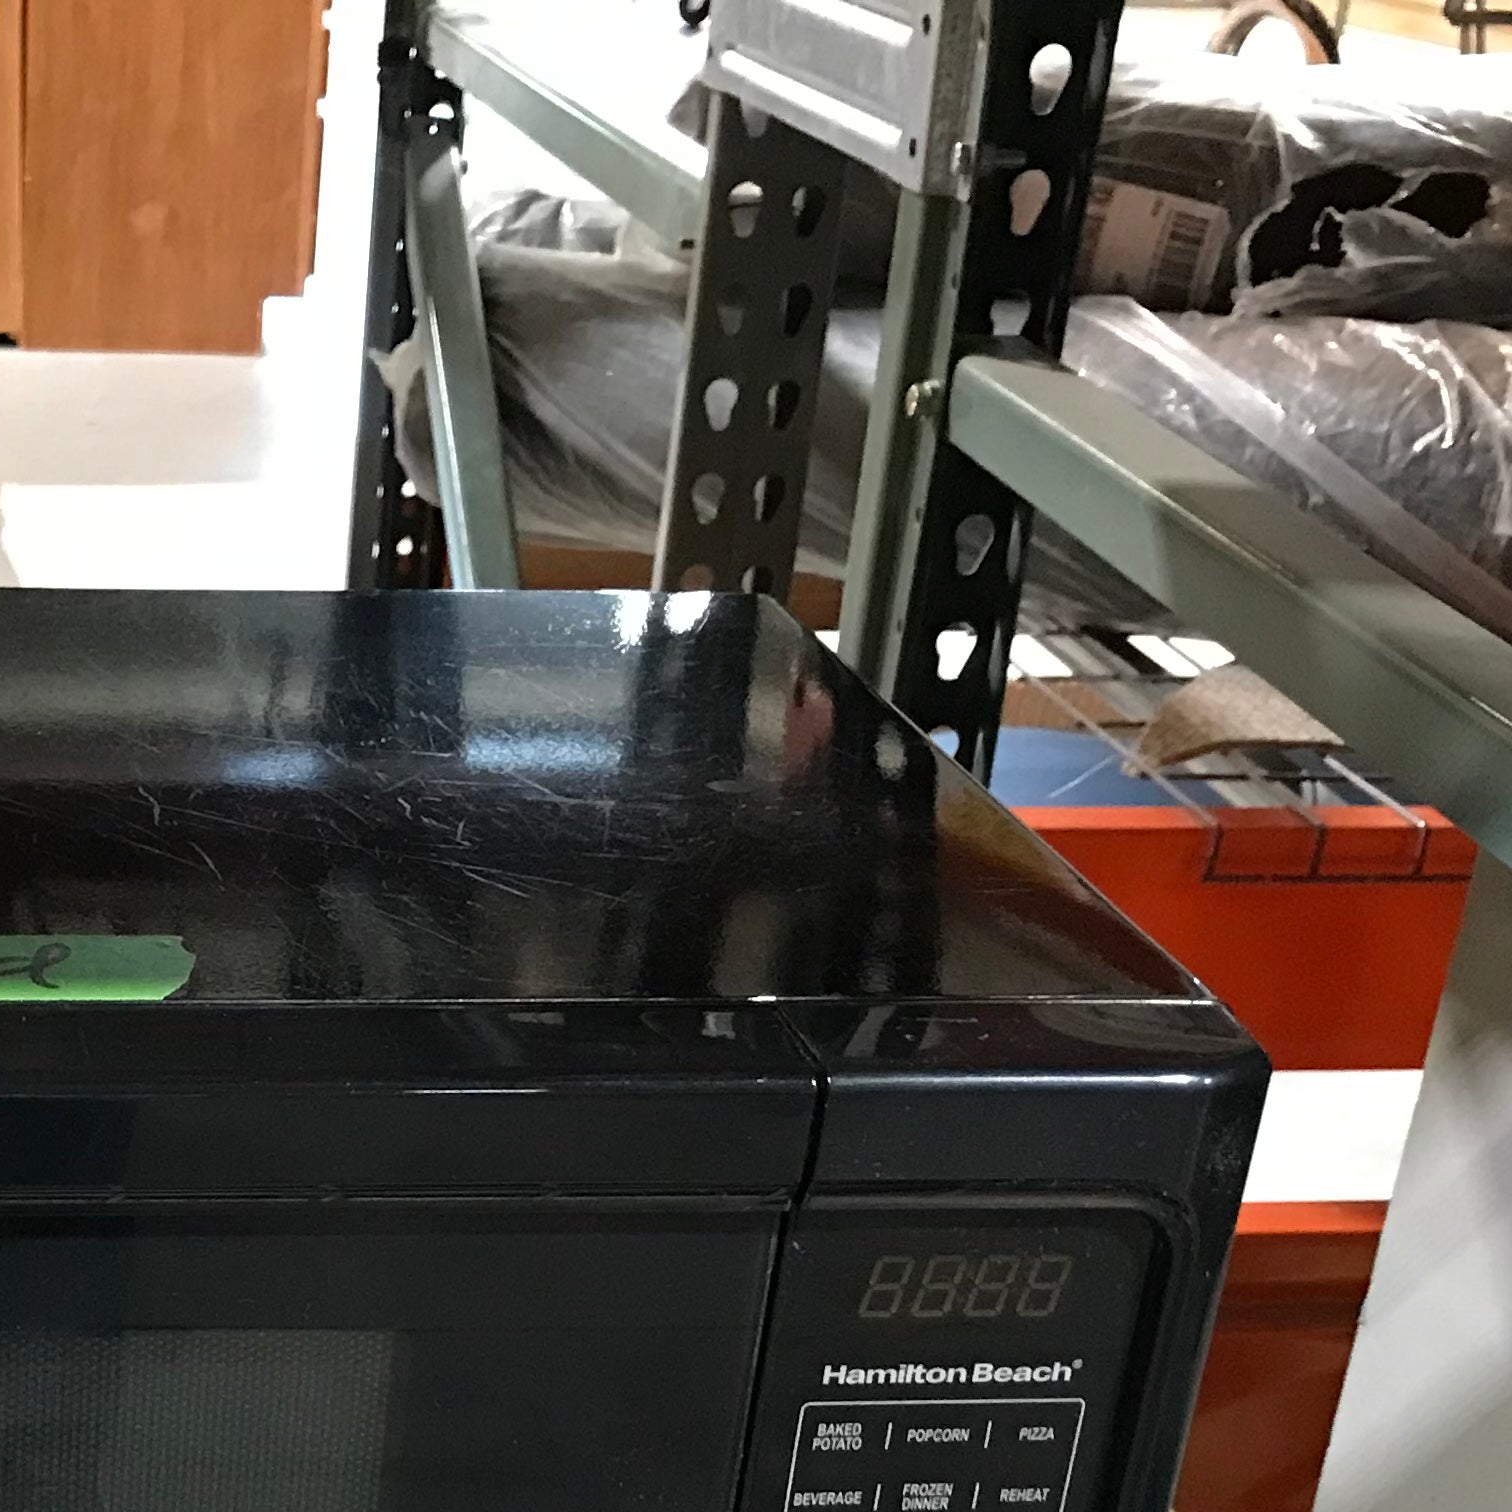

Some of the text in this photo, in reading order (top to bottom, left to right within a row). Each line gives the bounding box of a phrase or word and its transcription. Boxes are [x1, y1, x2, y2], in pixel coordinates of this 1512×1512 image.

[821, 1361, 1073, 1385] Hamilton Beach
[816, 1422, 863, 1437] BAKED
[906, 1427, 971, 1443] POPCORN
[1018, 1426, 1055, 1441] PIZZA
[811, 1436, 863, 1451] POTATO
[901, 1482, 954, 1497] FROZEN
[998, 1487, 1051, 1502] REHEAT
[792, 1490, 863, 1507] BEVERAGE
[900, 1496, 950, 1511] DINNER
